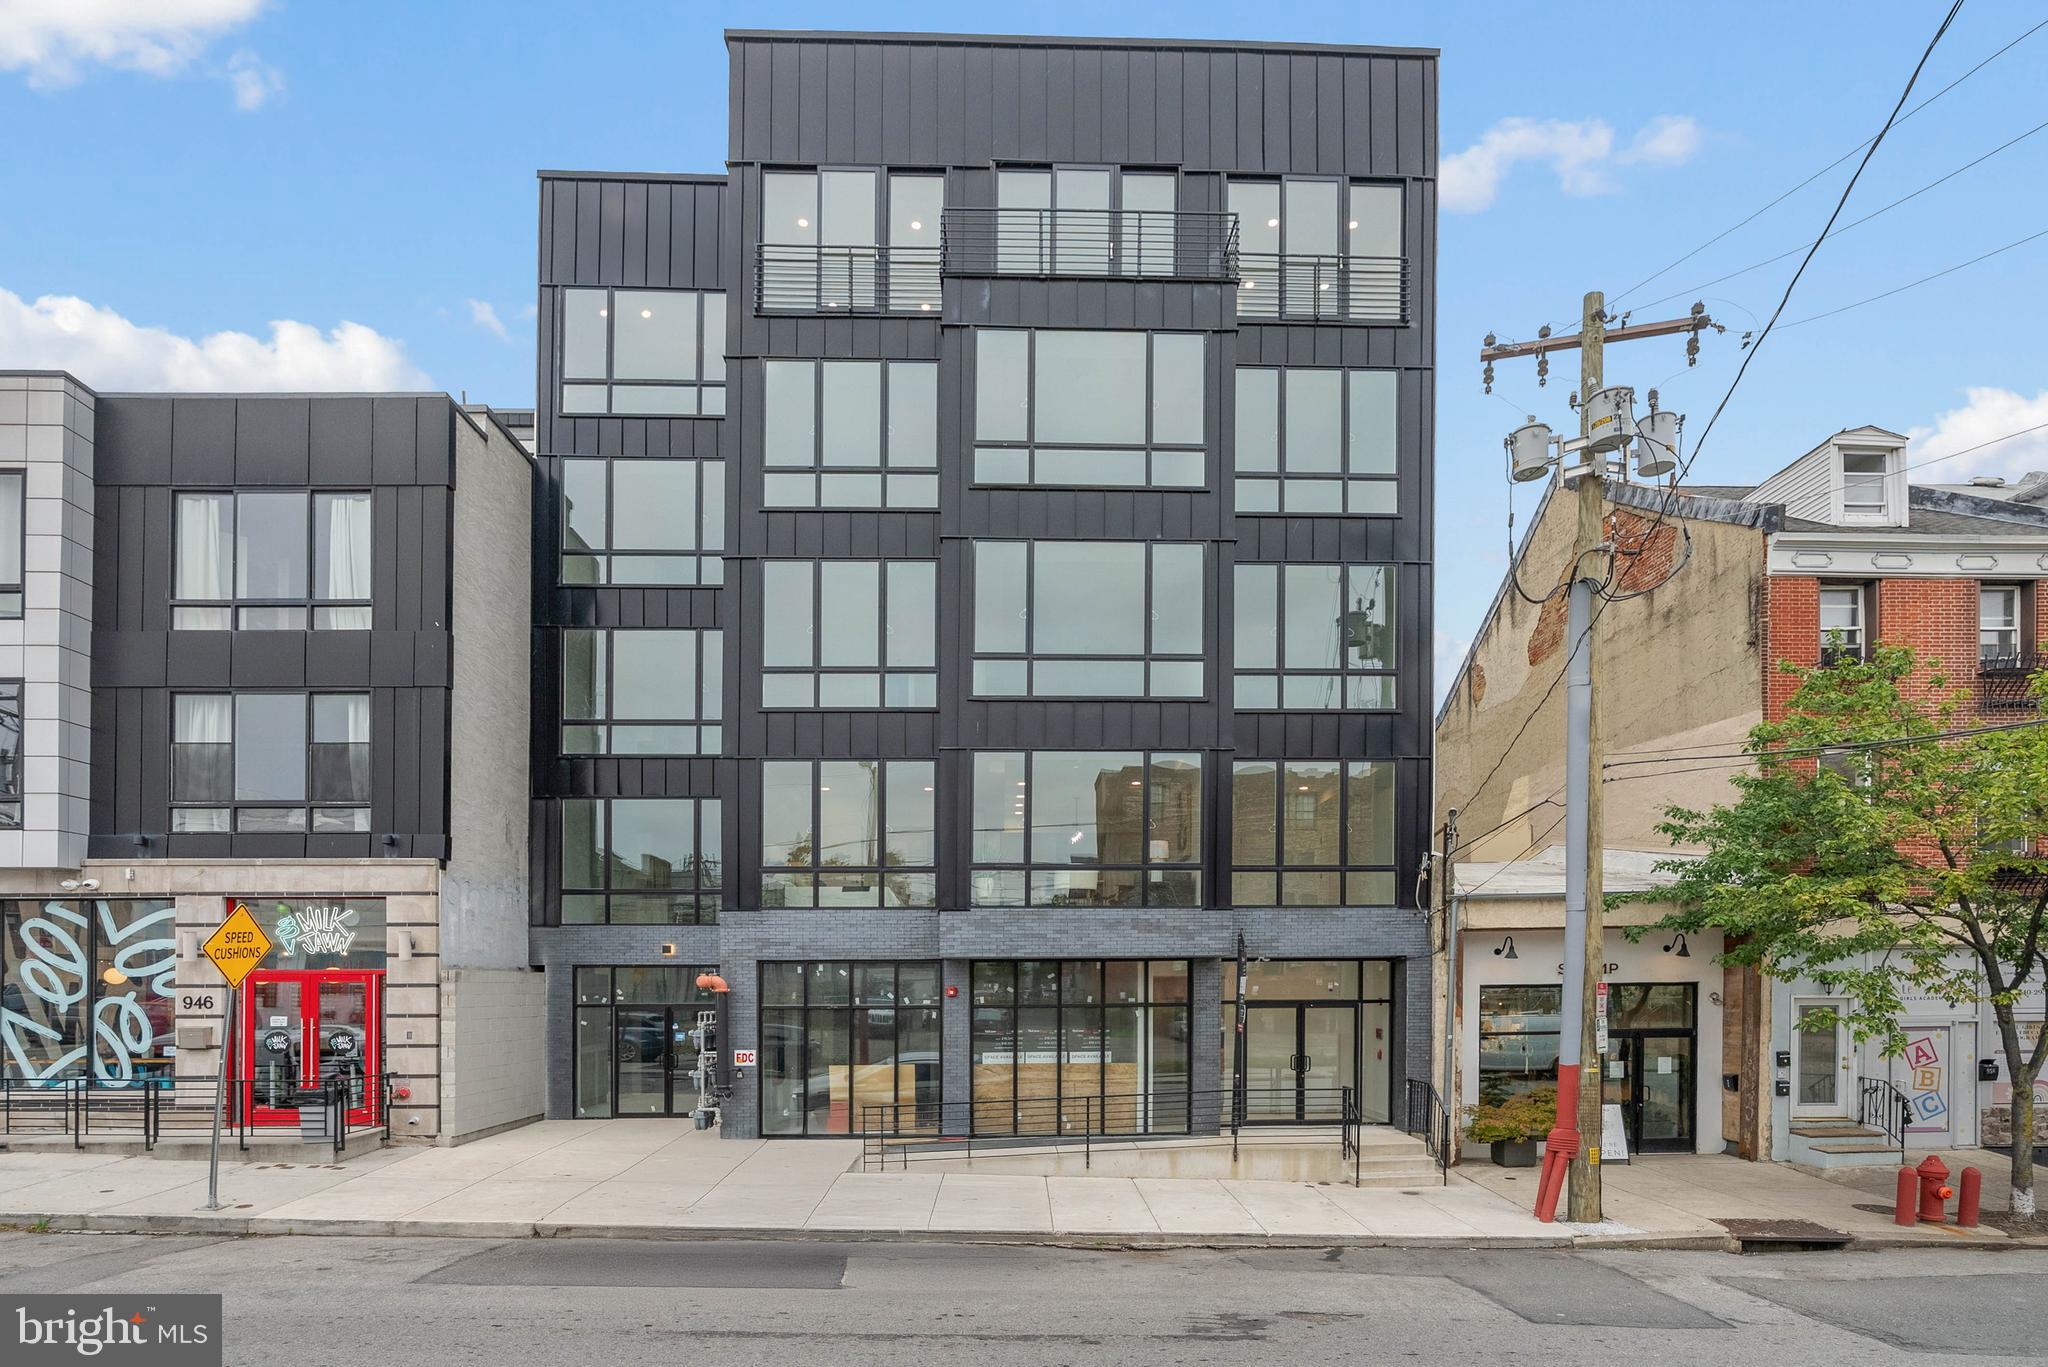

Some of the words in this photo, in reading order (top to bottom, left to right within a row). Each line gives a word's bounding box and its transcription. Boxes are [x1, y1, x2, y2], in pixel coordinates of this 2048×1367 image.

[296, 906, 353, 936] MILK
[224, 931, 254, 944] SPEED
[297, 932, 356, 955] JAWN
[213, 946, 261, 960] CUSHIONS
[183, 996, 214, 1009] 946
[271, 1035, 288, 1044] MILK
[336, 1035, 352, 1044] MILK
[736, 1053, 754, 1063] FDC
[1914, 1045, 1932, 1064] A
[1919, 1070, 1935, 1087] B
[1922, 1096, 1939, 1113] C
